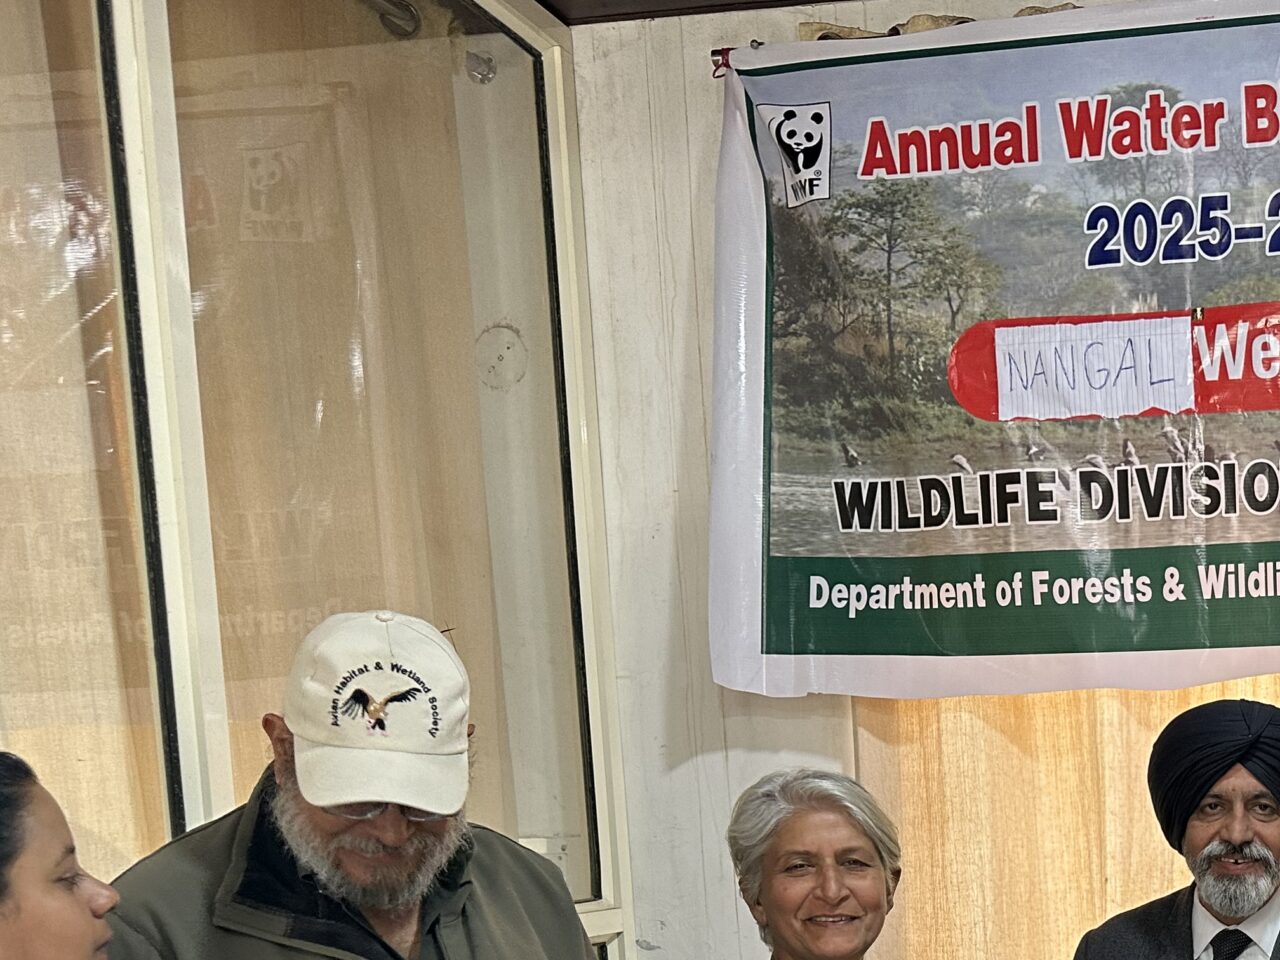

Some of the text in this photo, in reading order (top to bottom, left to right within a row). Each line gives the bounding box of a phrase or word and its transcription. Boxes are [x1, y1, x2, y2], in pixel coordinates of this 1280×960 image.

[858, 102, 1040, 179] Annual
[1058, 90, 1226, 161] Water
[1006, 336, 1175, 393] NANGAL
[833, 468, 1060, 532] WILDLIFE
[808, 573, 987, 618] Department
[995, 571, 1023, 608] of
[1031, 568, 1153, 606] Forests
[1162, 566, 1187, 602] &
[334, 664, 371, 695] Habitat
[374, 661, 384, 671] &
[390, 662, 432, 694] Wetland
[428, 696, 441, 738] Society
